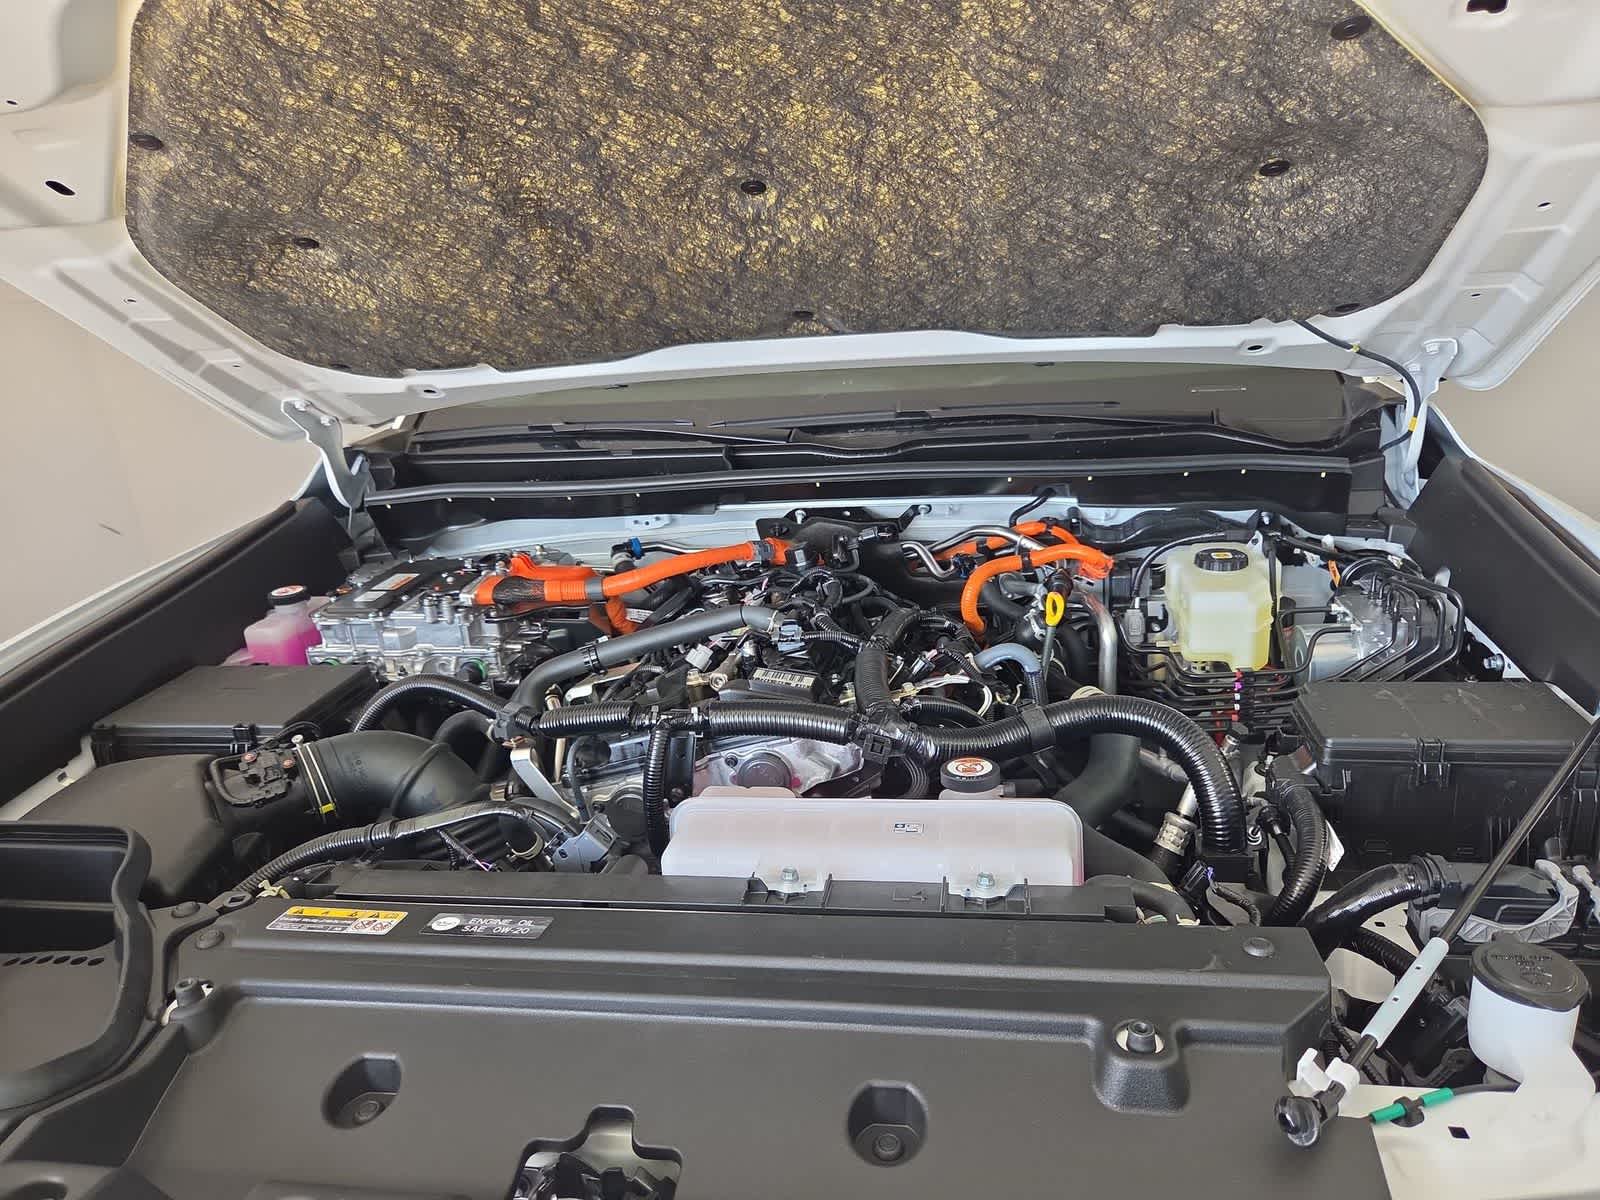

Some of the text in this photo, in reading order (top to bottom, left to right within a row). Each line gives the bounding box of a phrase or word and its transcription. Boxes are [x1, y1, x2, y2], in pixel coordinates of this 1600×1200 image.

[469, 917, 536, 927] ENGINE OIL
[461, 925, 531, 935] SAE 0W-20
